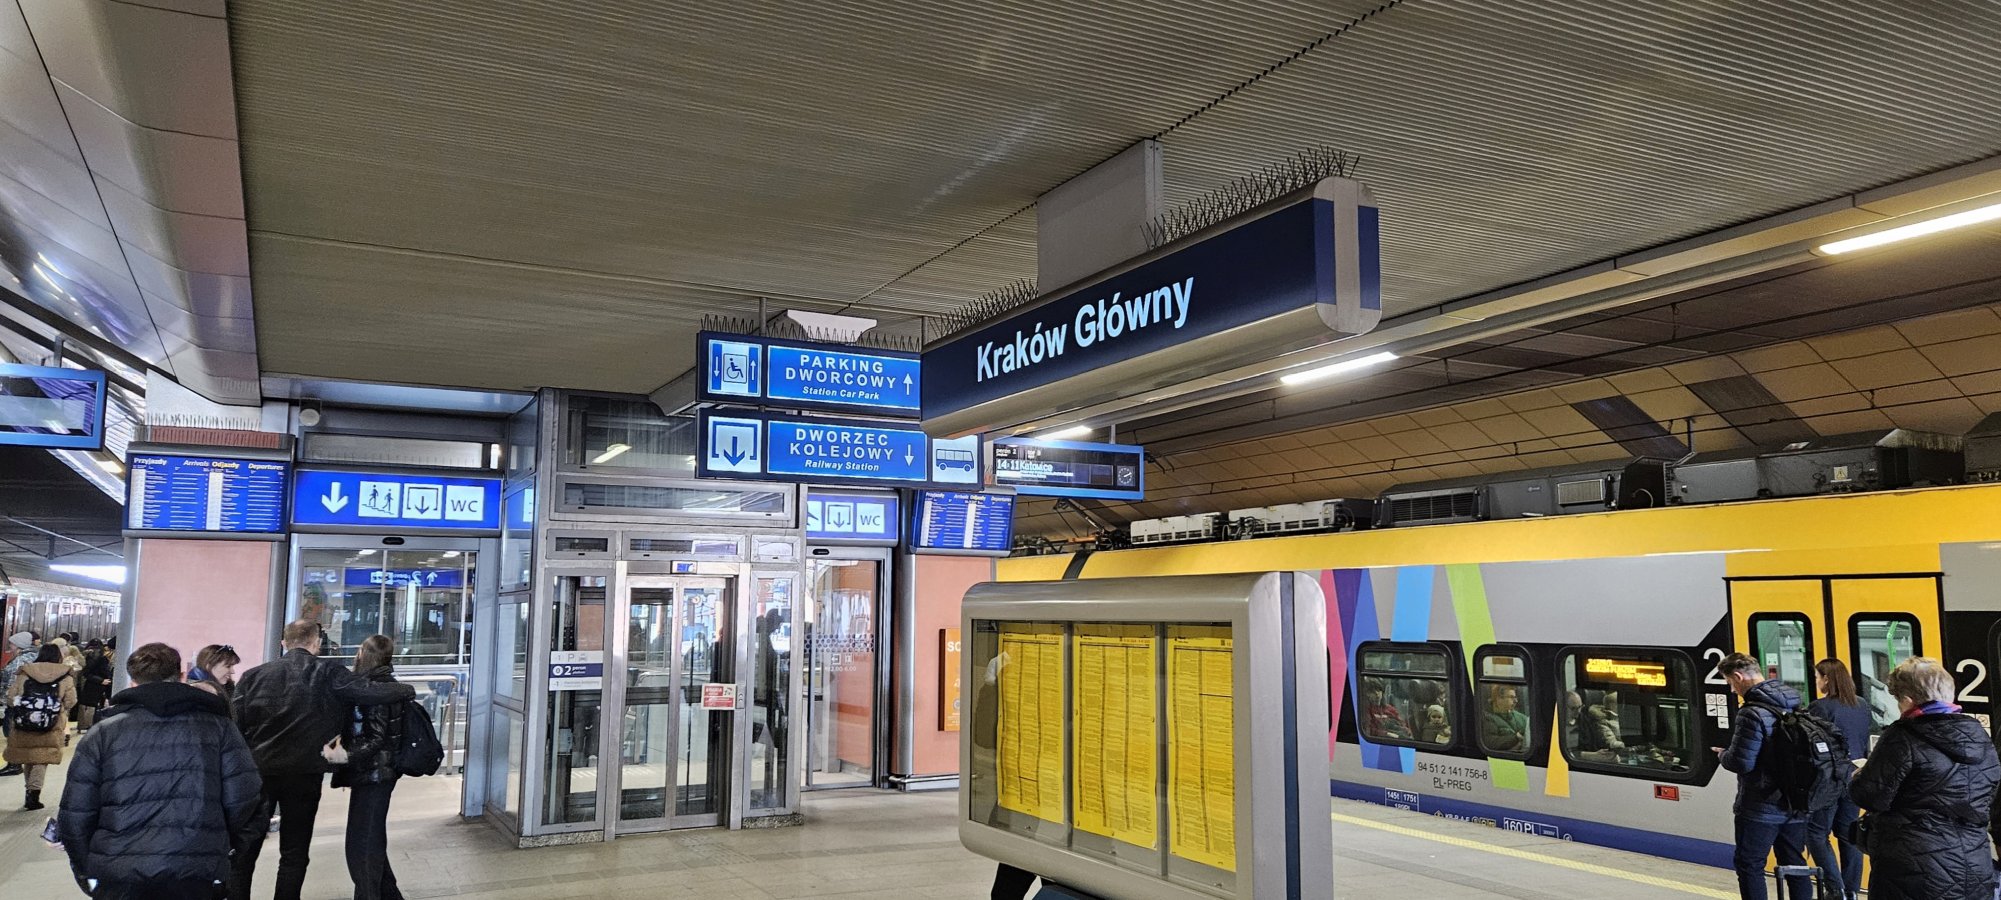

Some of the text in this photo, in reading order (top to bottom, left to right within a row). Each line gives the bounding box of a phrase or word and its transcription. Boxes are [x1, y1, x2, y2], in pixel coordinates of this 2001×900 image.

[977, 277, 1194, 382] Kraków Główny
[800, 354, 884, 373] PARKING
[785, 367, 896, 389] DWORCOWY
[802, 386, 880, 400] Station Car Park
[795, 428, 888, 446] DWORZEC
[790, 442, 894, 460] KOLEJOWY
[134, 457, 284, 471] Przyjazdy Arrivals Odjazdy Departures
[805, 459, 879, 472] Railway Station
[997, 459, 1053, 472] 14:11 Katowice
[451, 499, 478, 512] WC
[860, 515, 881, 526] WC
[564, 665, 572, 676] 2
[1703, 647, 1729, 685] 2
[1956, 658, 1989, 703] 2
[1417, 761, 1488, 780] 94 51 2 141 756-8
[1433, 777, 1472, 791] PL-PREG
[1403, 794, 1417, 803] 175t
[1504, 820, 1522, 833] 160
[1524, 822, 1538, 836] PL
